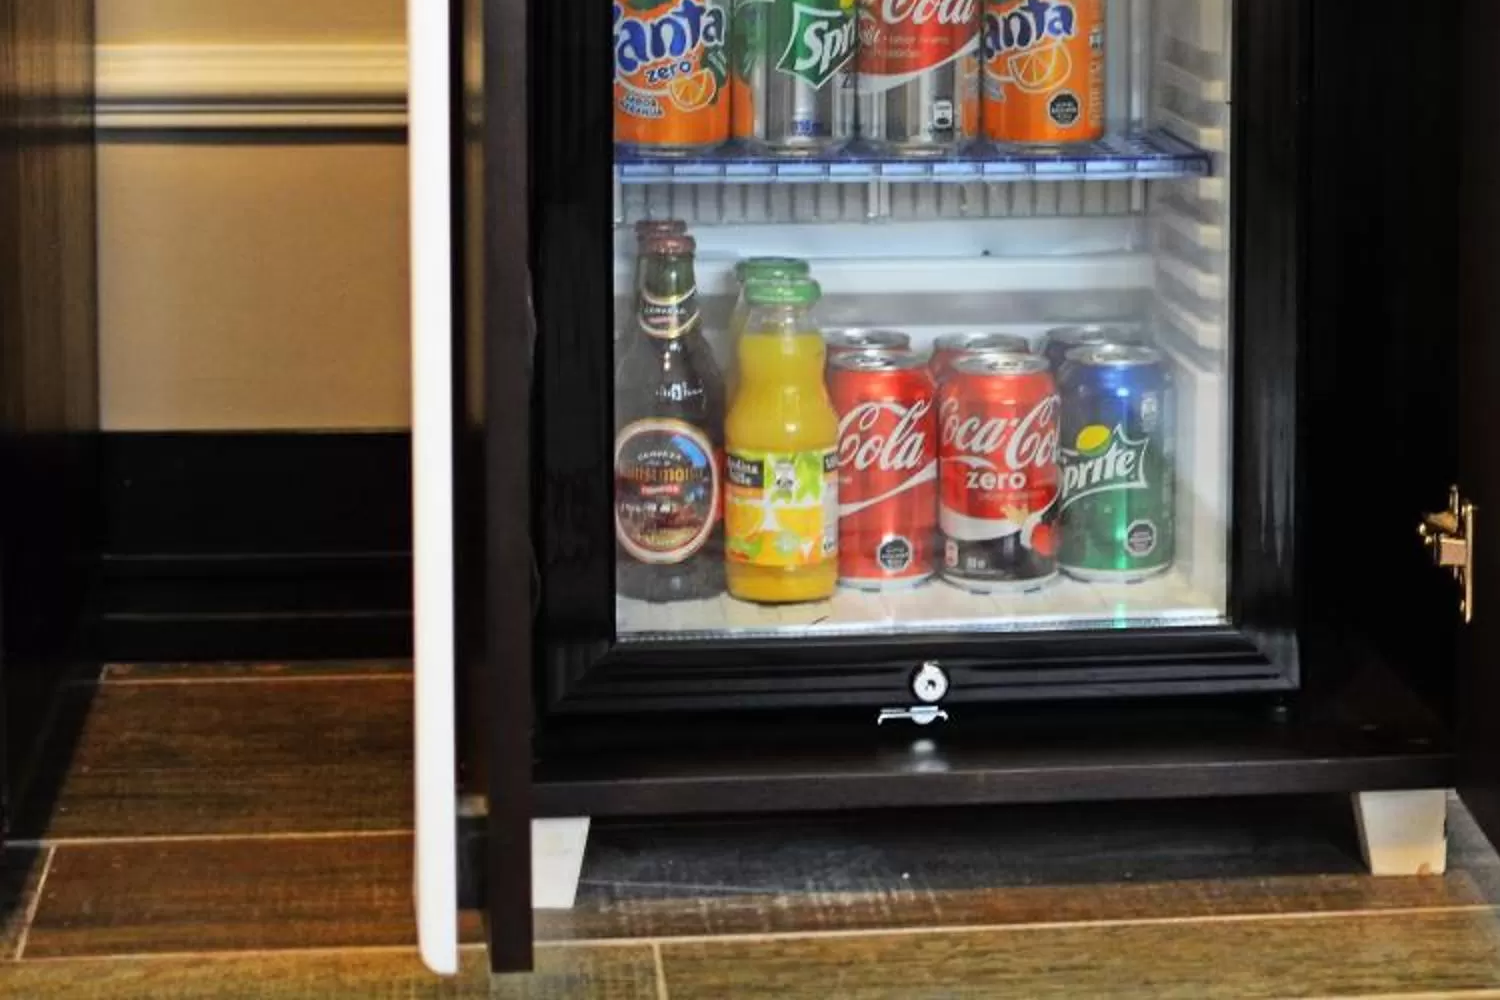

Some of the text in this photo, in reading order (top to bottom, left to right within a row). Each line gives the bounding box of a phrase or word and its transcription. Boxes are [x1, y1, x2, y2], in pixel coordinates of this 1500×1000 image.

[645, 60, 692, 83] zero
[966, 471, 1027, 490] zero
[1060, 444, 1136, 498] prite
